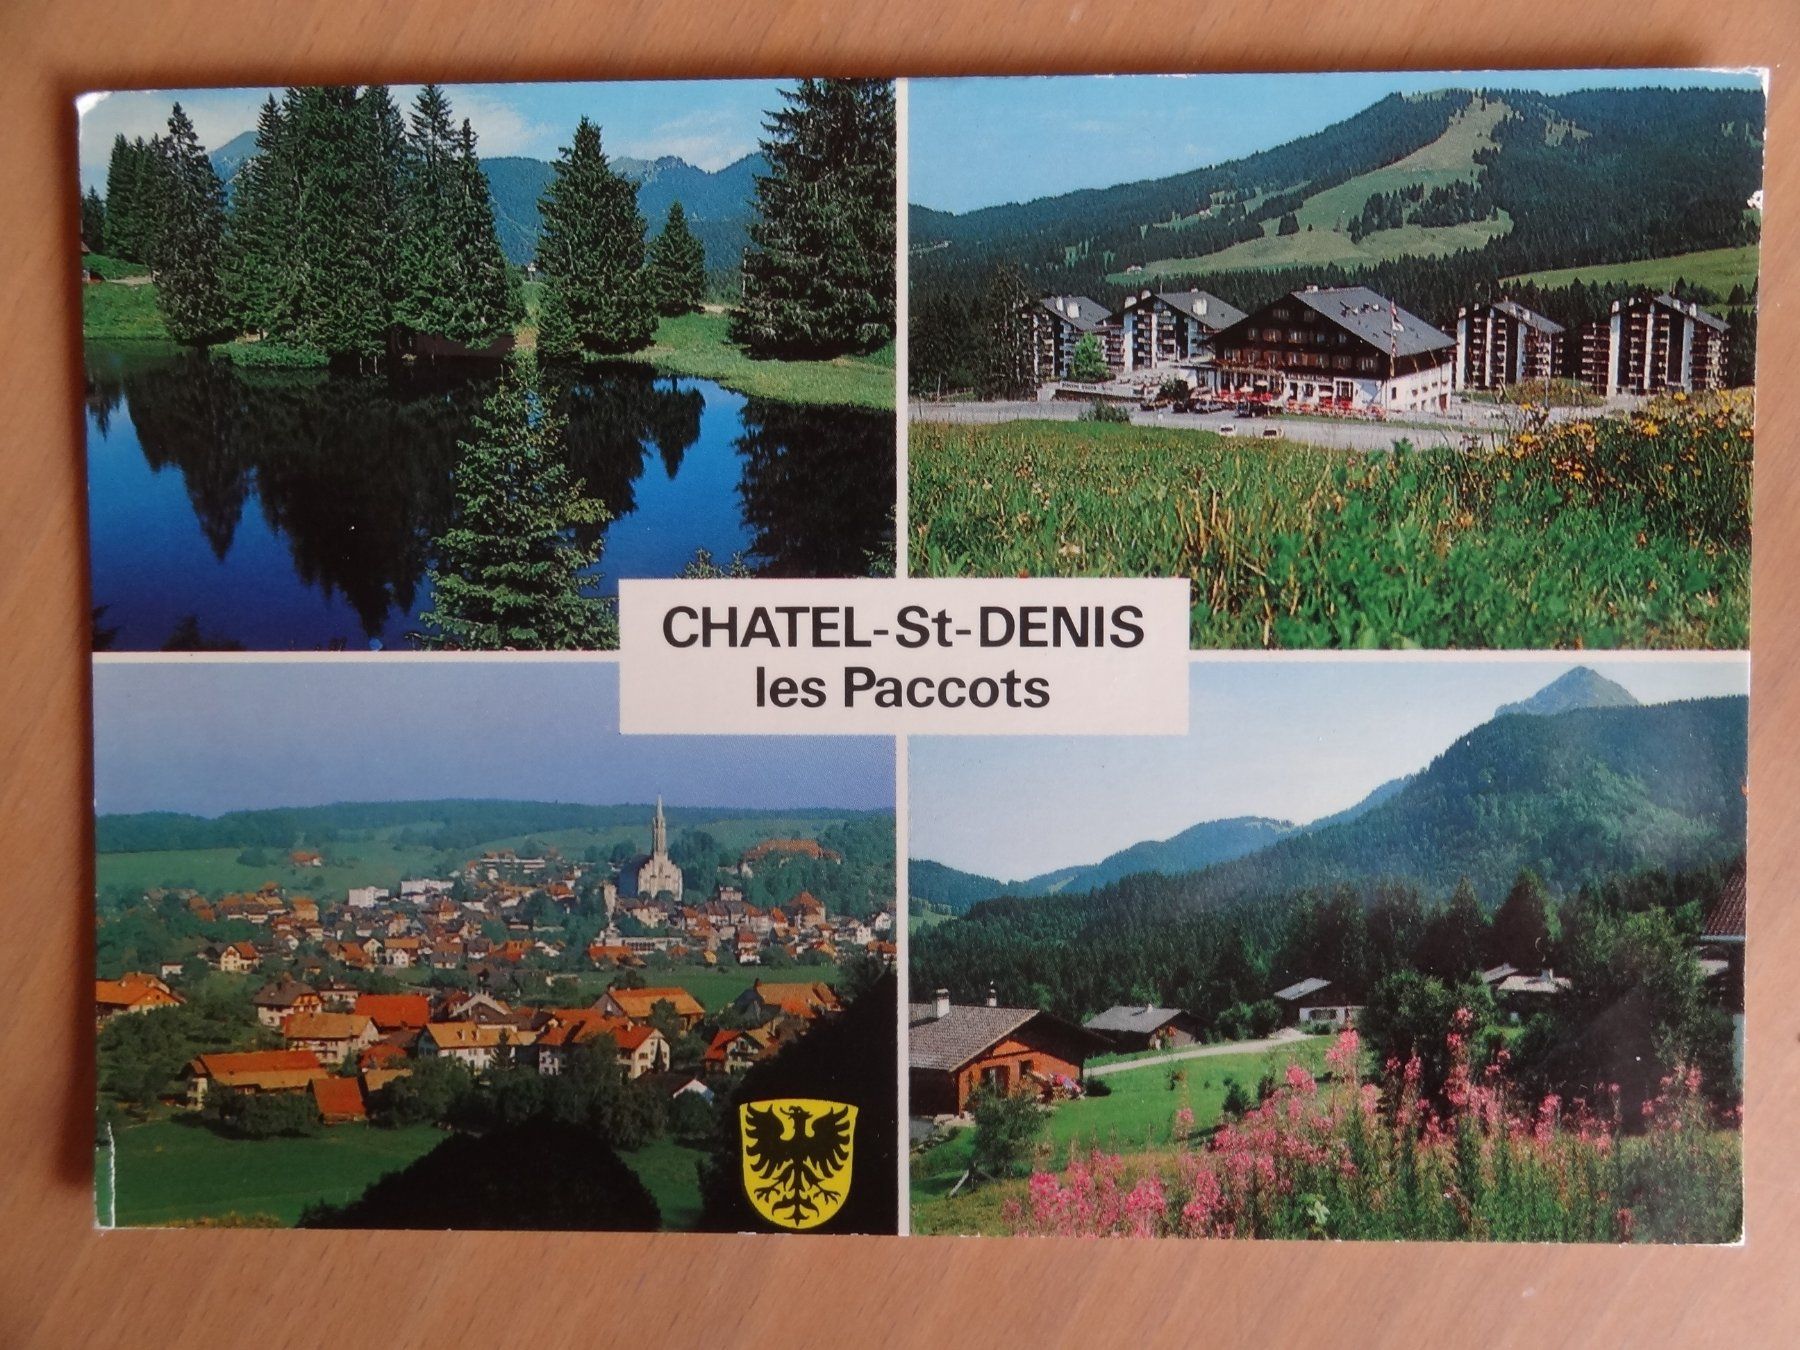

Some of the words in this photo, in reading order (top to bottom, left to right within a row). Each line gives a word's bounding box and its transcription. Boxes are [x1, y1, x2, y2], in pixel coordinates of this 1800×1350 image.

[662, 605, 1145, 649] CHATEL-St-DENIS
[756, 666, 827, 708] les
[844, 666, 1050, 708] Paccots
